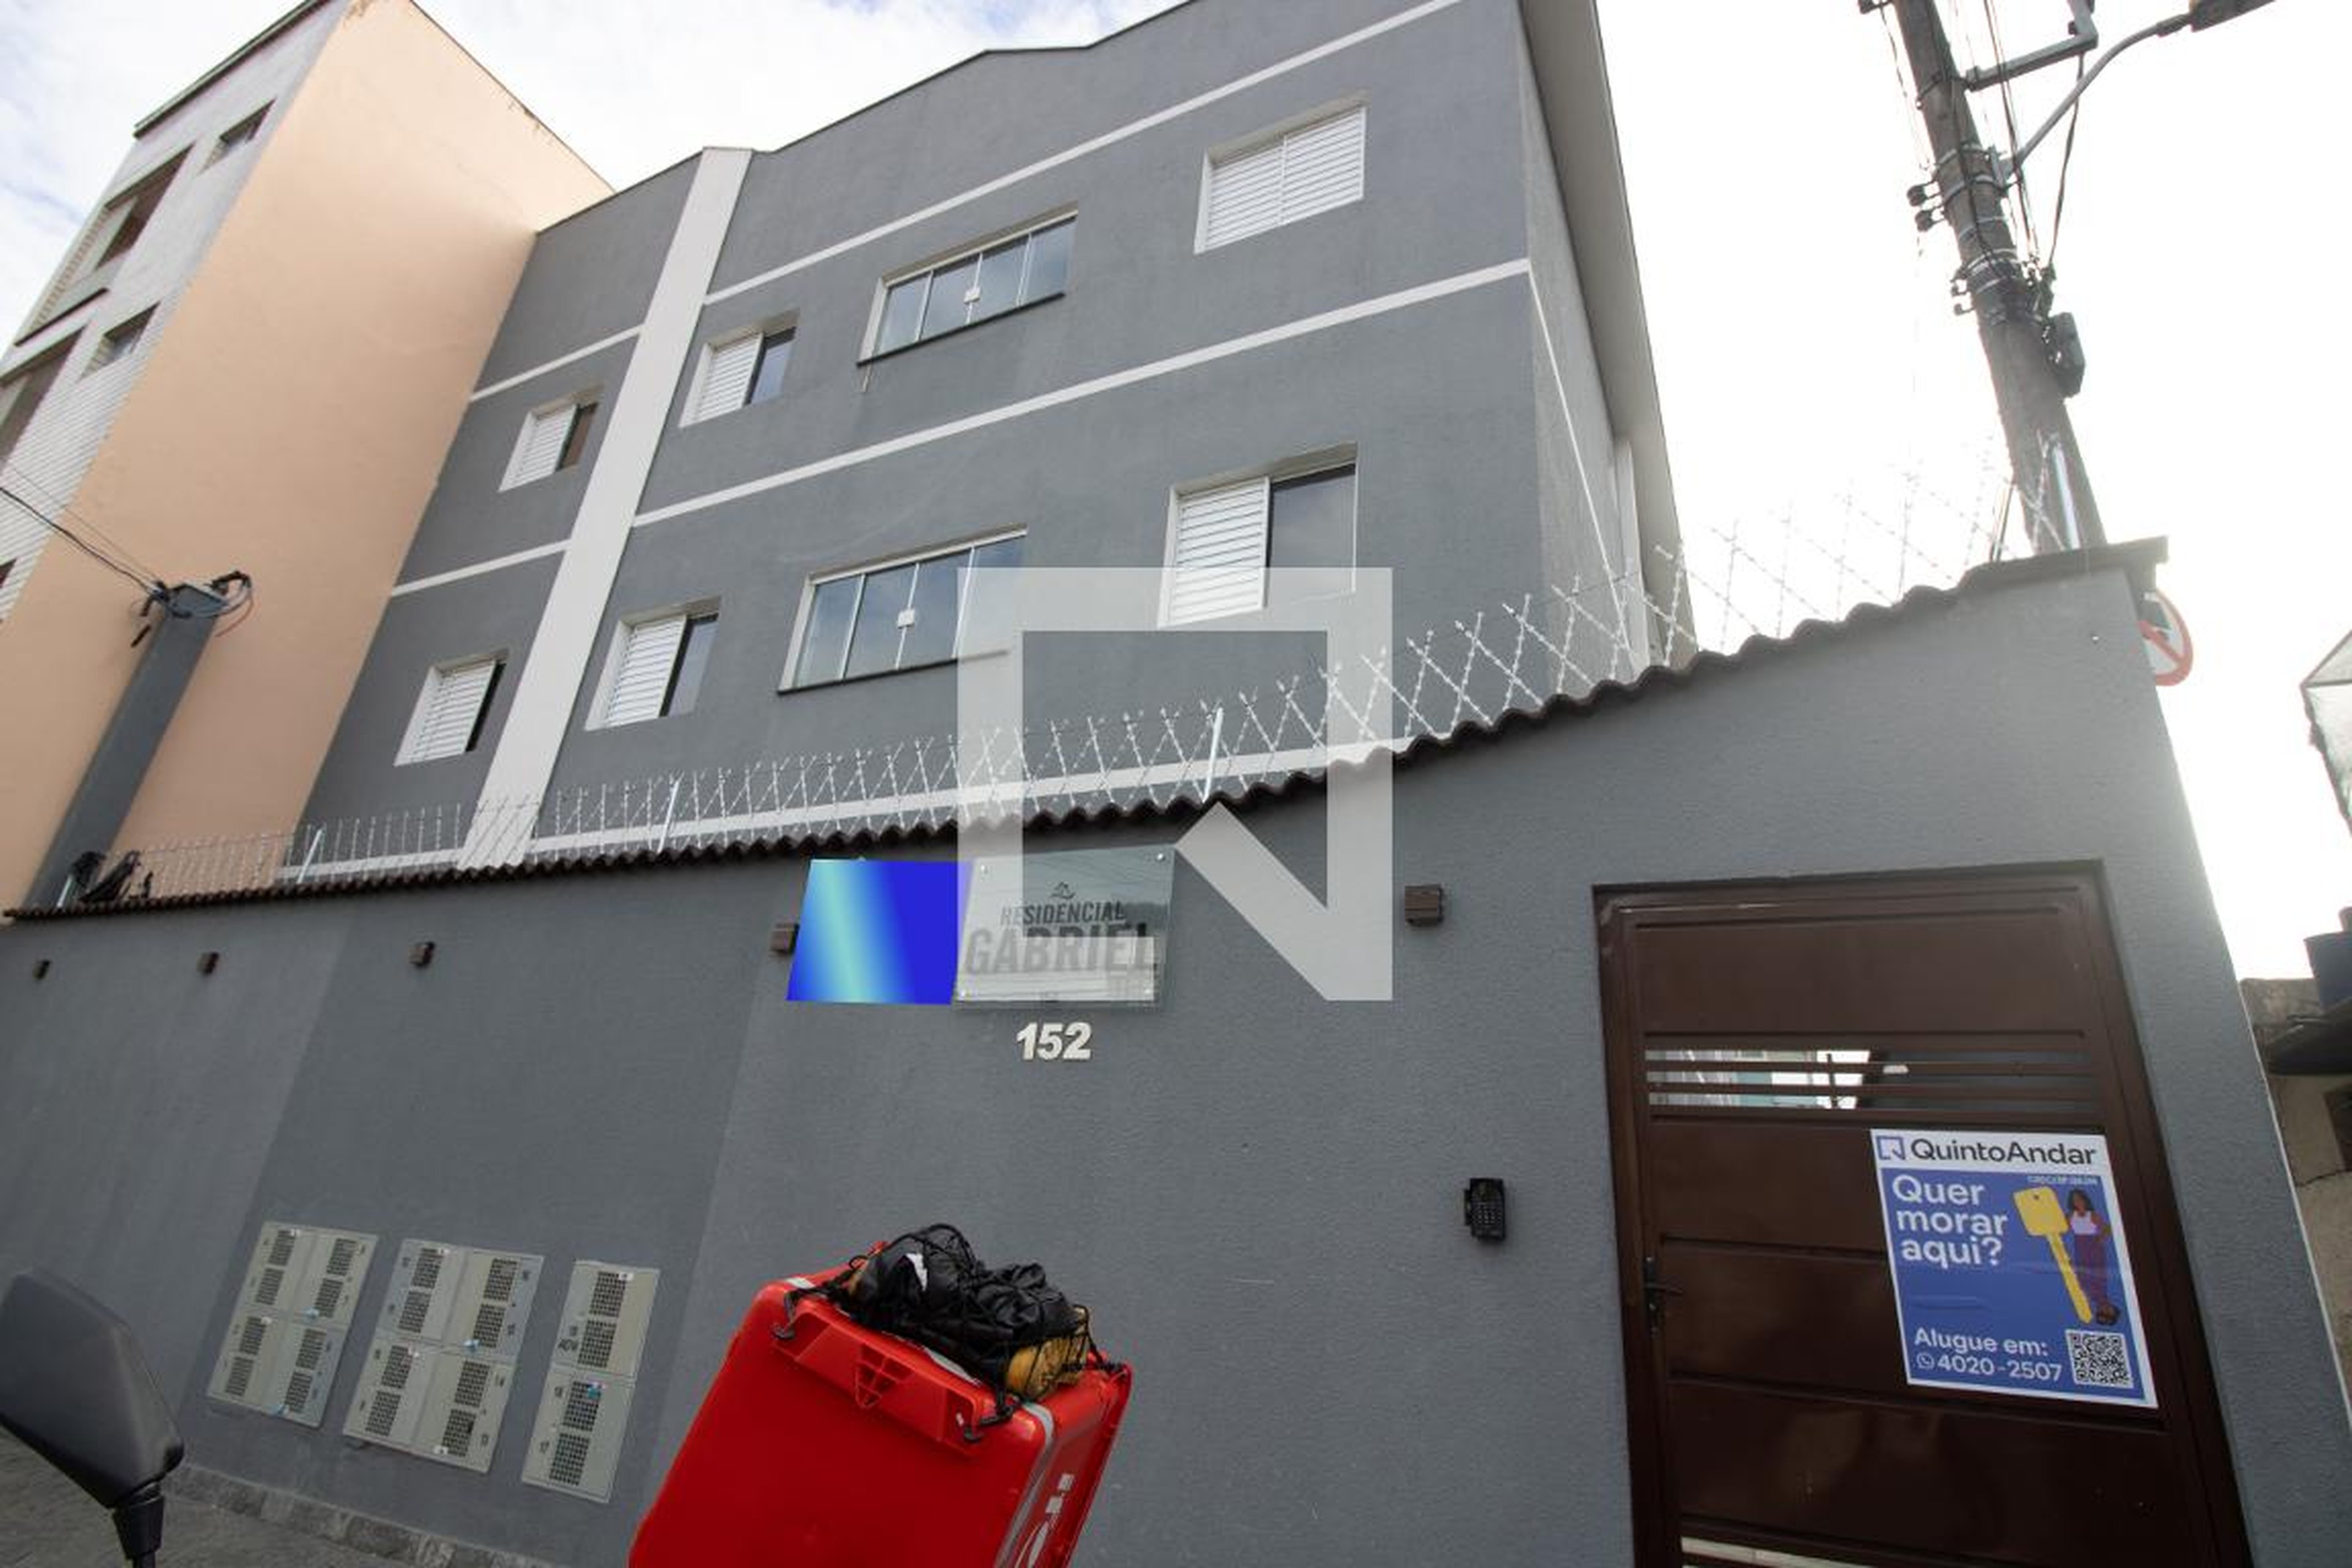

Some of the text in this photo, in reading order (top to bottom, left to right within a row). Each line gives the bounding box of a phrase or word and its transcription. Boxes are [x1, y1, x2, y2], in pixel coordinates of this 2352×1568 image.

[1000, 901, 1127, 926] RESIDENCIAL
[964, 922, 1157, 974] GABRIEL
[1016, 1021, 1092, 1060] 152
[1910, 1138, 2097, 1164] QuintoAndar
[1892, 1174, 1985, 1205] Quer
[1896, 1210, 2008, 1236] morar
[1902, 1236, 2002, 1269] aqui?
[1914, 1327, 2048, 1357] Alugue em:
[1937, 1354, 2063, 1382] 4020-2507
